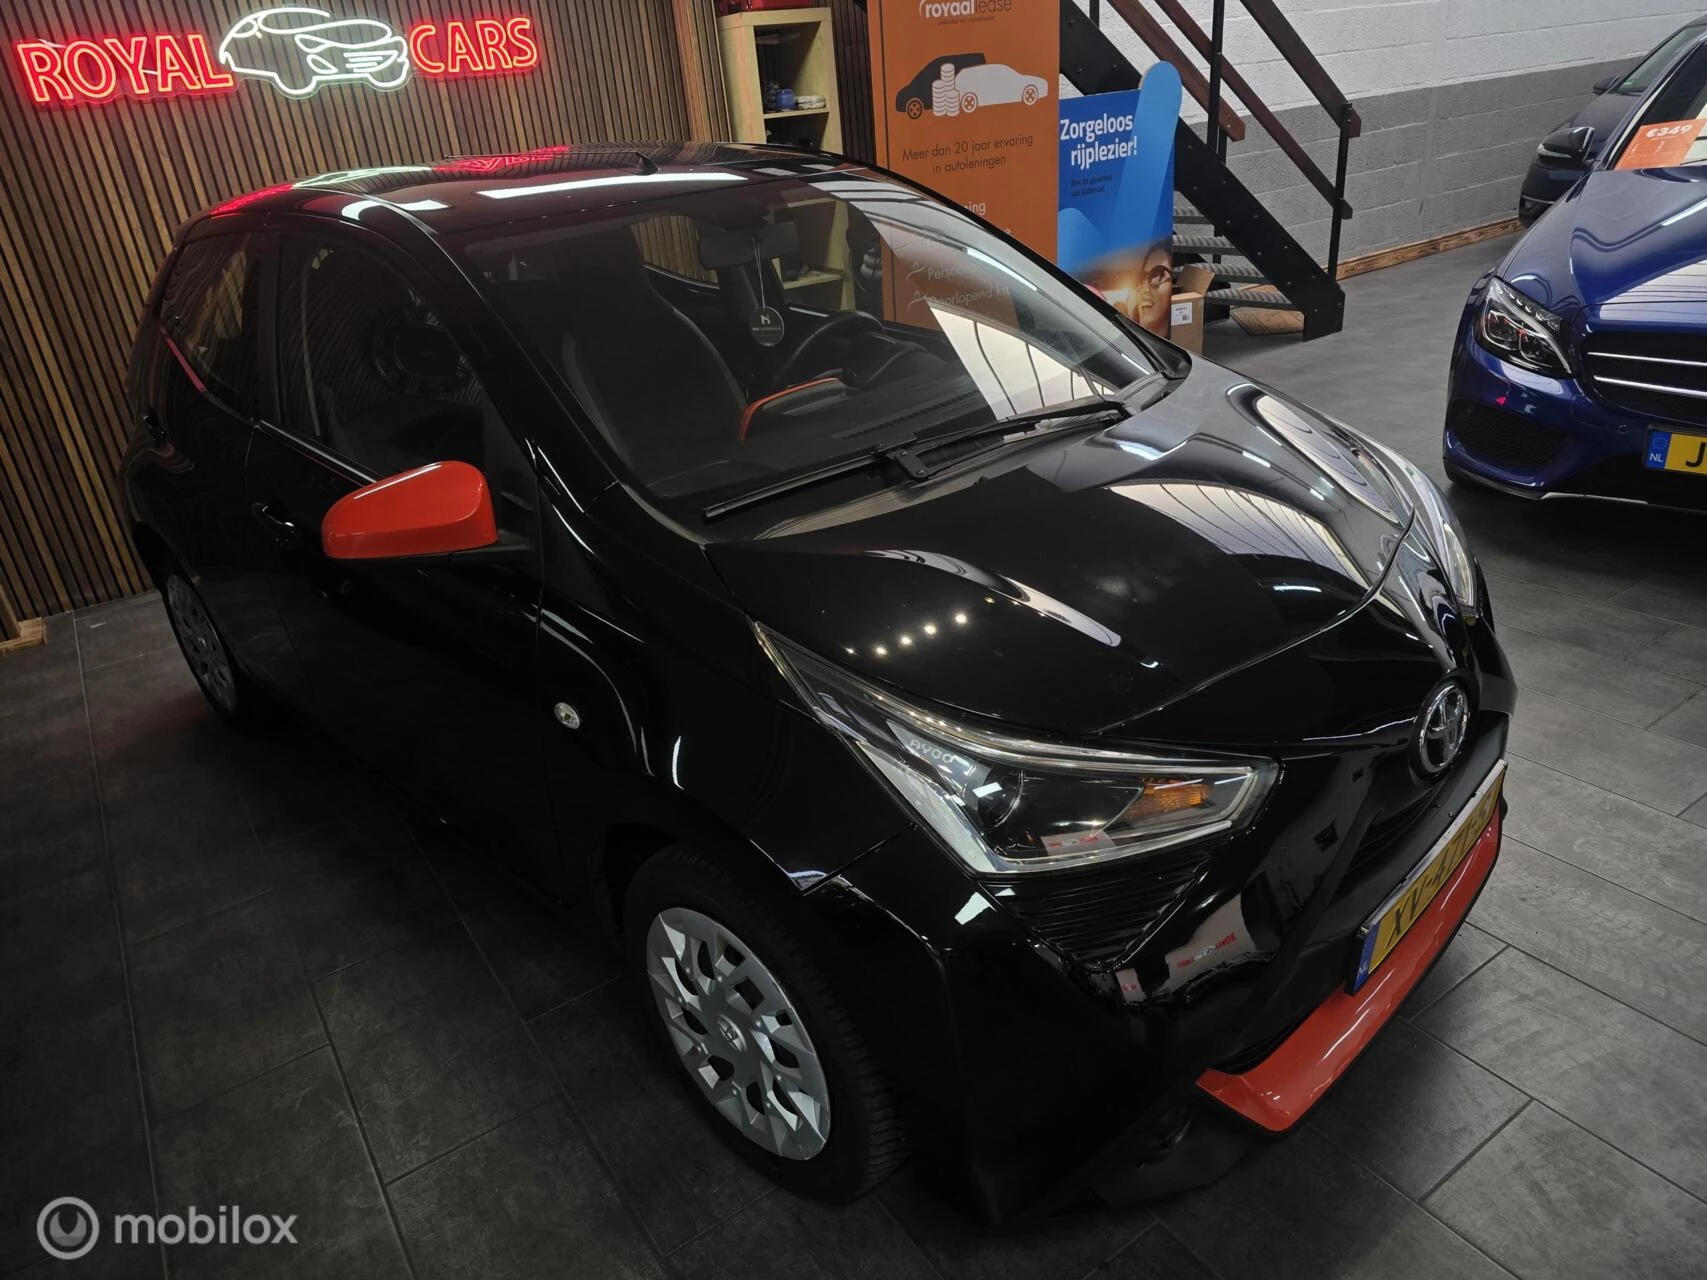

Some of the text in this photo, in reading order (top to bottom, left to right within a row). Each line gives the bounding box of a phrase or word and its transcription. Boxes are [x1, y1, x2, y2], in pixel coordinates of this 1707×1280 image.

[16, 16, 541, 103] ROYAL CARS
[1060, 112, 1133, 143] Zorgeloos
[902, 134, 1033, 161] Meer dan 20 jaar ervaring
[1071, 135, 1137, 170] rijplezier!
[933, 155, 1007, 174] in autoleningen
[1649, 453, 1664, 463] NL
